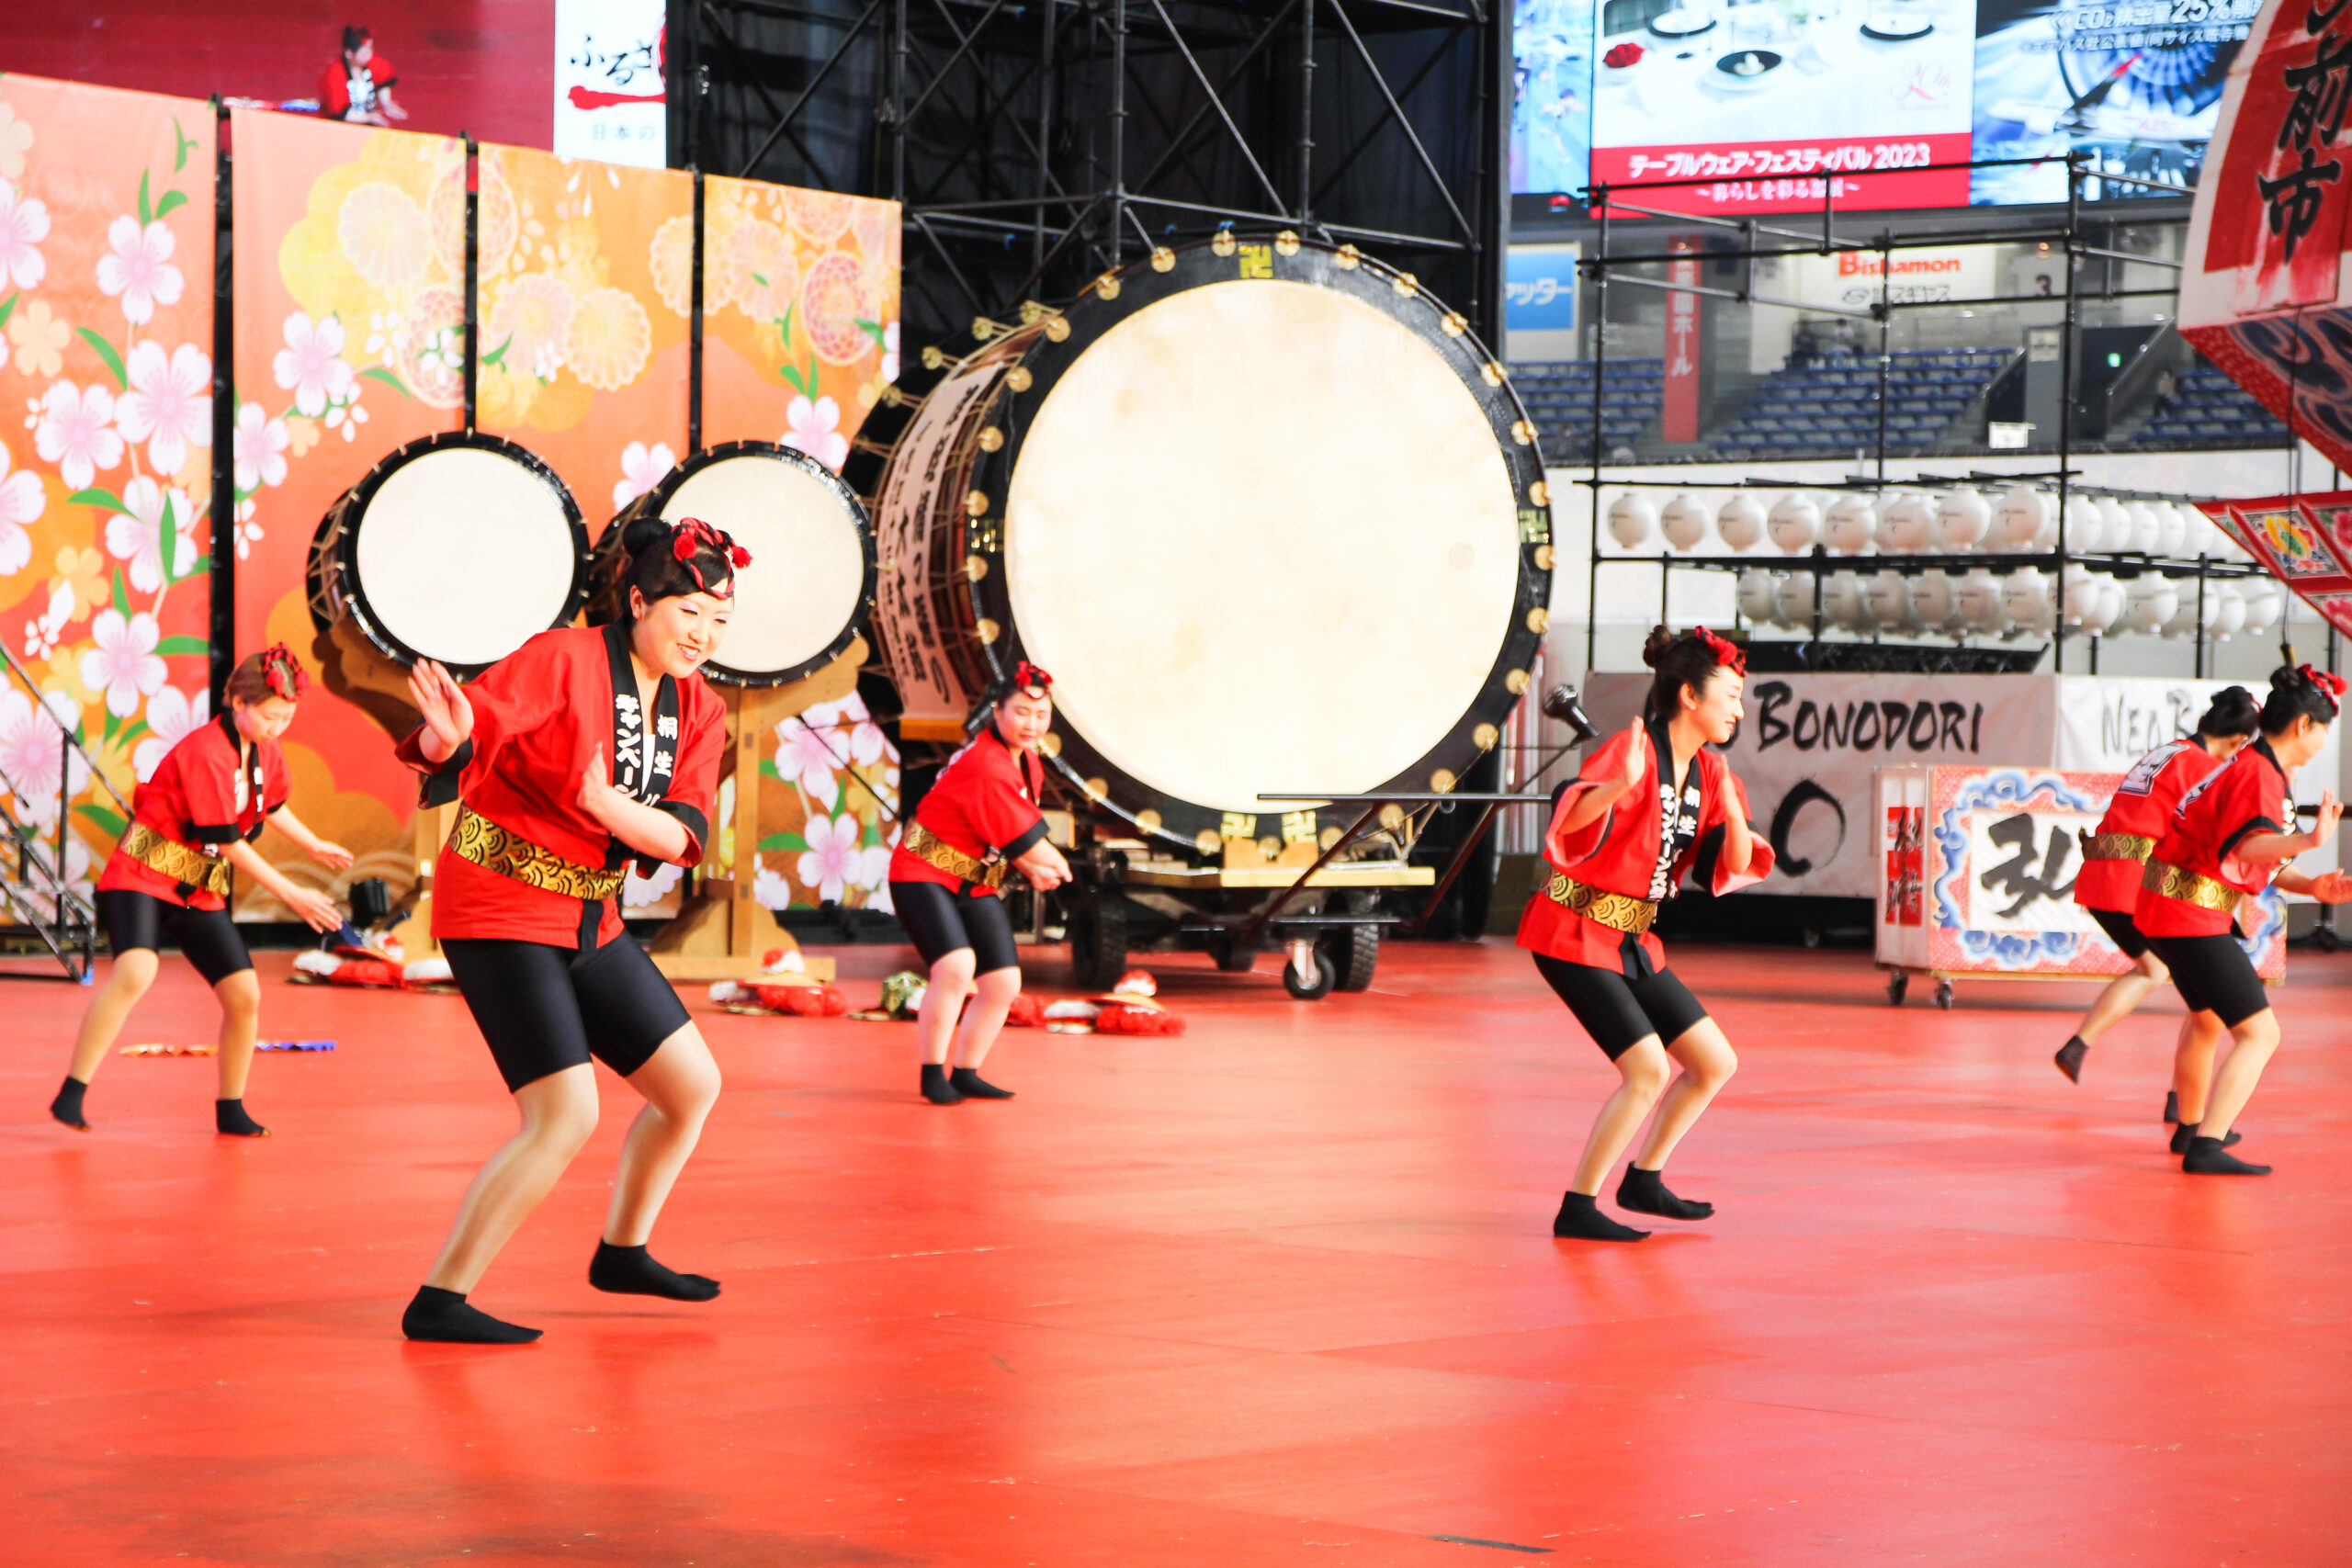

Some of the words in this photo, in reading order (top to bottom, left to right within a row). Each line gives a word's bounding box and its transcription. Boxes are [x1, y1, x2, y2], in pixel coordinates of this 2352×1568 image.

[1873, 142, 1931, 170] 2023
[1838, 251, 1961, 276] Bishamon
[2034, 275, 2052, 297] 3
[1753, 681, 1984, 754] BONODORI
